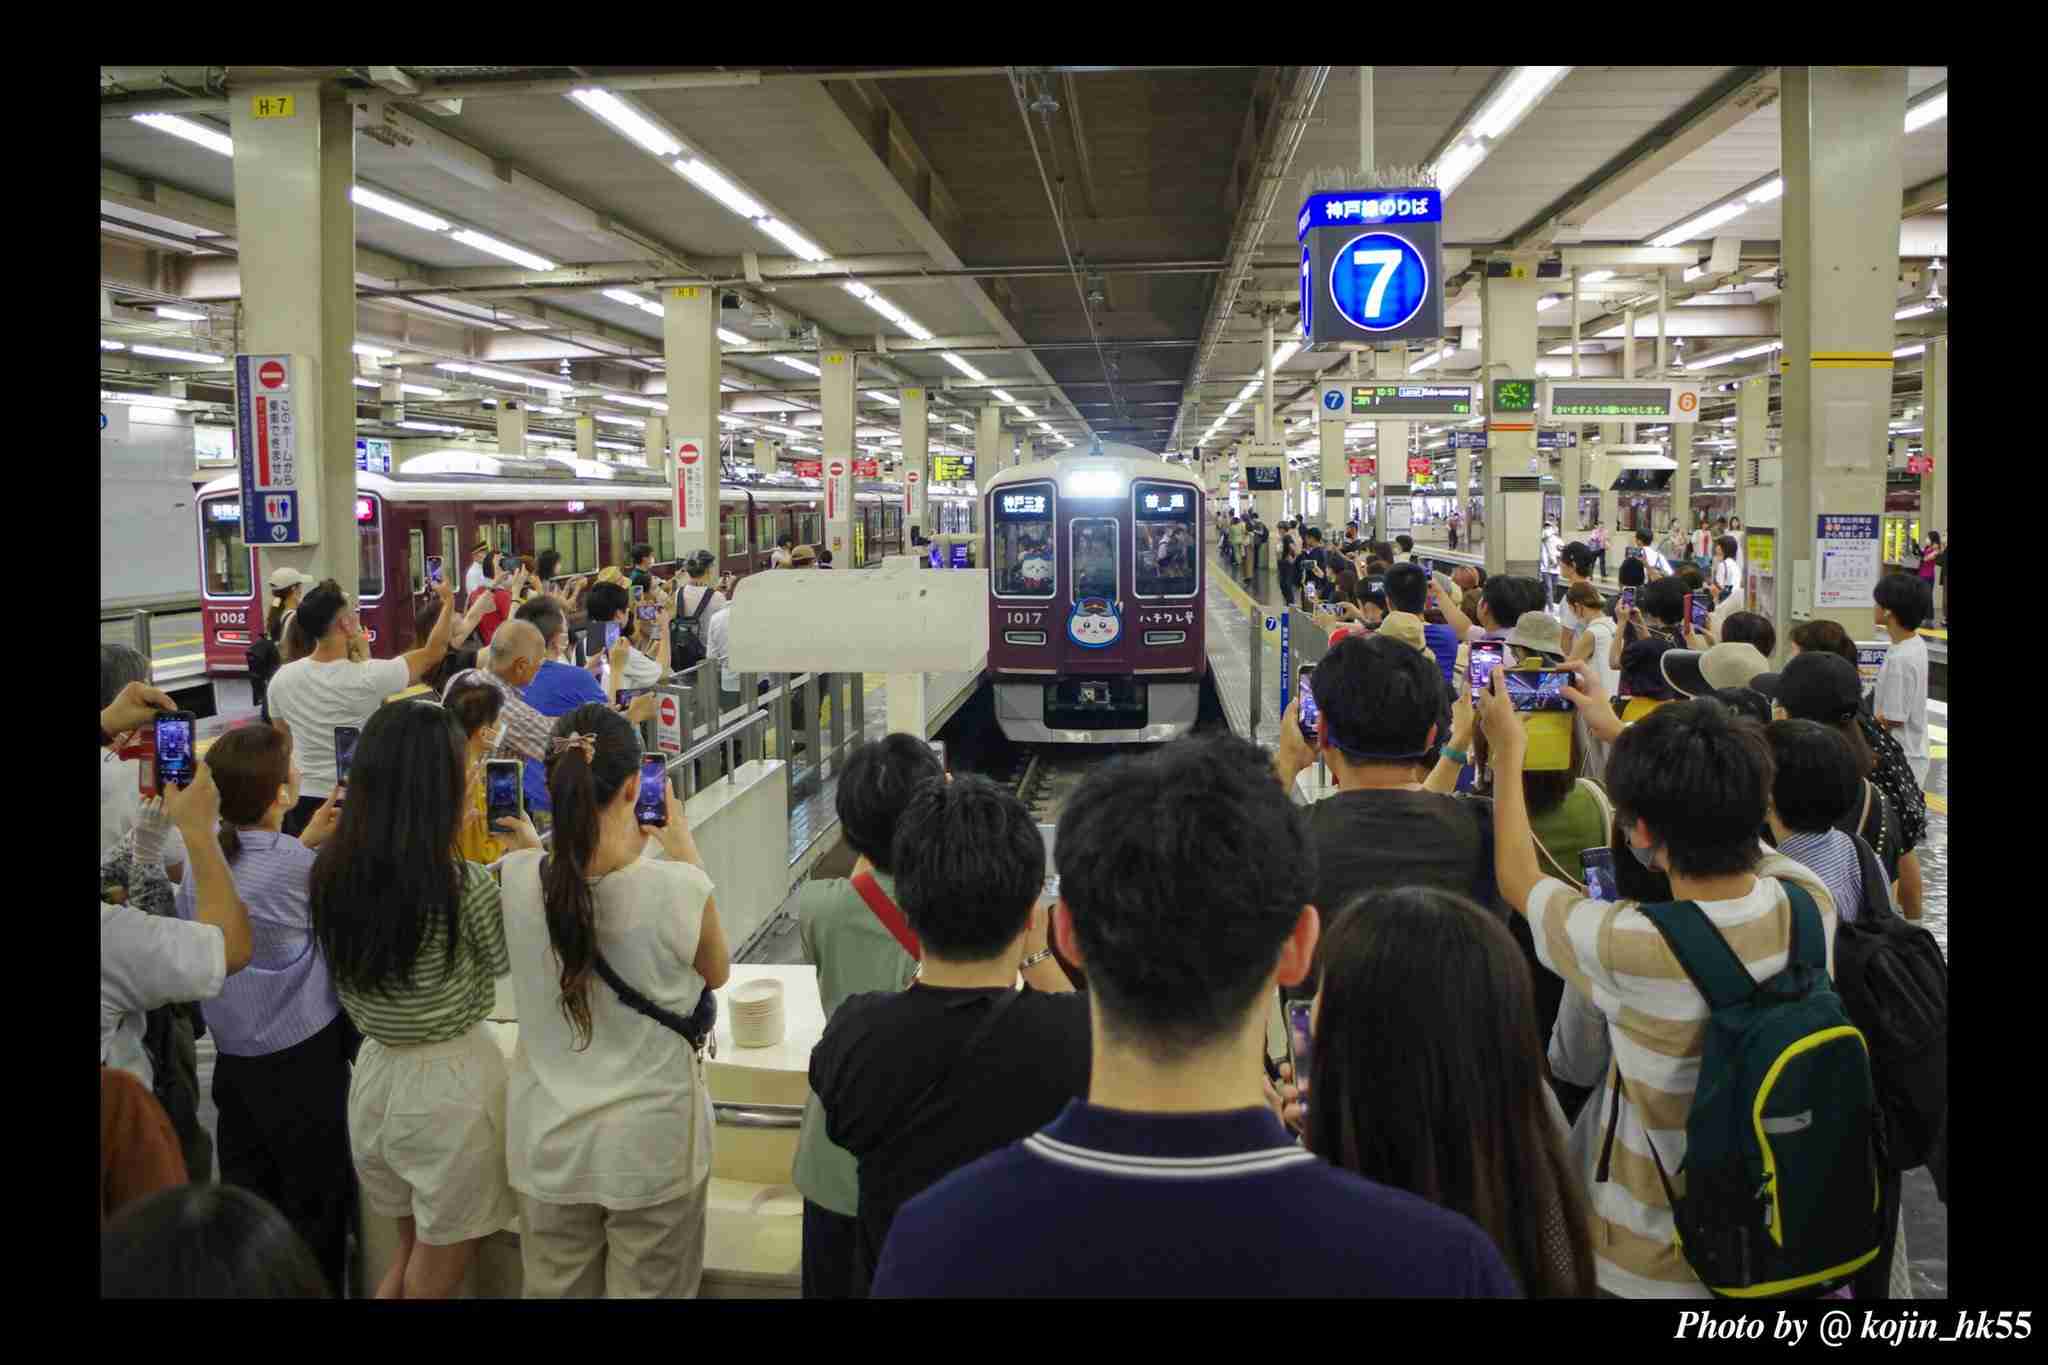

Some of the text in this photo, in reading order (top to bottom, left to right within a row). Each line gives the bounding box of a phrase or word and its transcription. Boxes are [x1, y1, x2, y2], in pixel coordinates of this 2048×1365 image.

[259, 97, 287, 115] H-7
[1325, 197, 1429, 219] 神戸線のりば
[1353, 249, 1403, 318] 7
[1329, 393, 1340, 409] 7
[280, 400, 295, 487] このホームから
[215, 612, 246, 624] 1002
[1007, 612, 1042, 624] 1017
